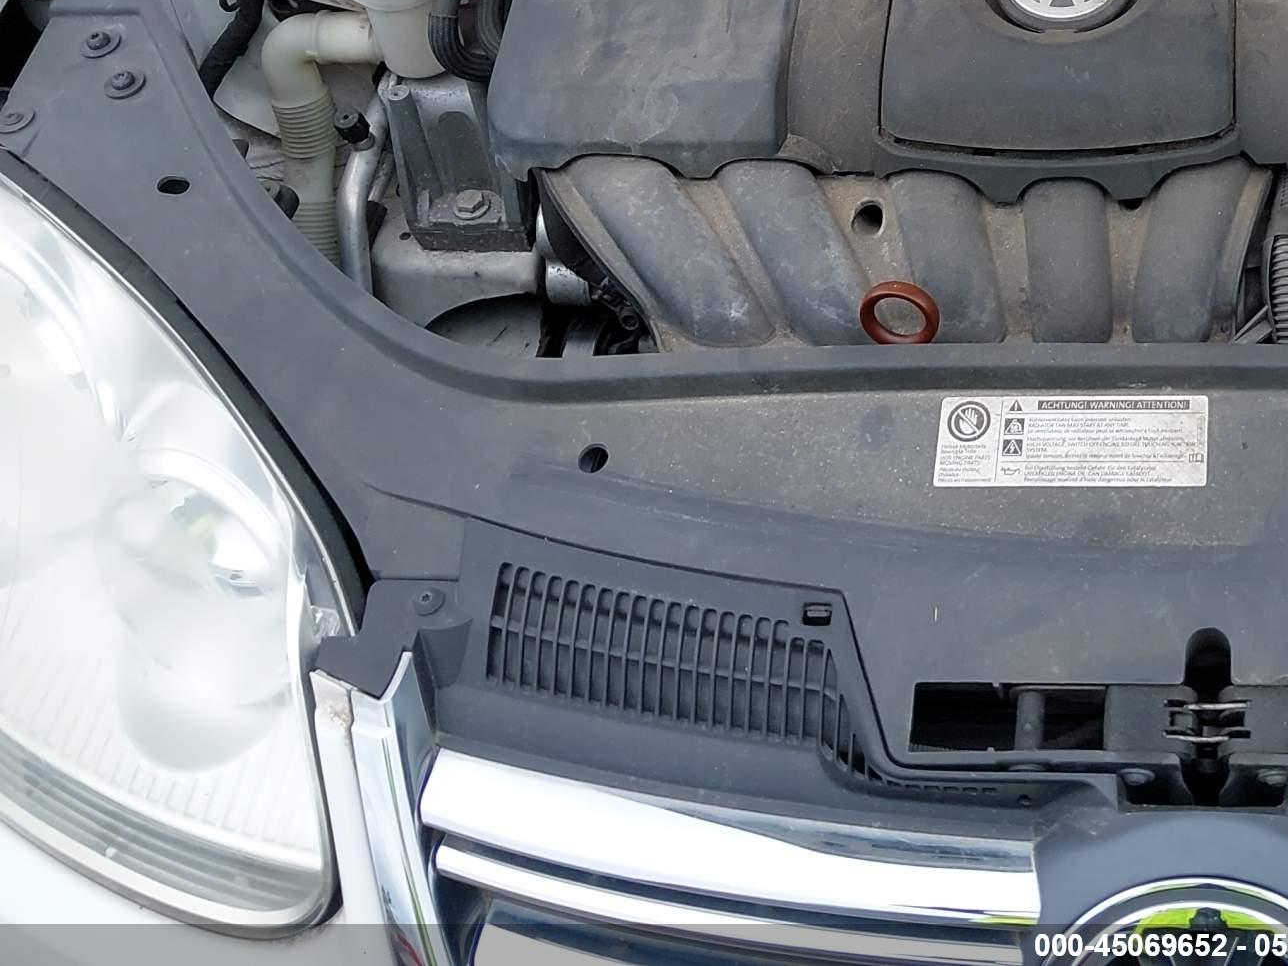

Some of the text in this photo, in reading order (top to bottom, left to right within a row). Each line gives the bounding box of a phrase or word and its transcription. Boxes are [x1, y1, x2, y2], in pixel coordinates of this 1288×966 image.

[1041, 400, 1187, 410] ACHTUNG! WARNING! ATTENTION!
